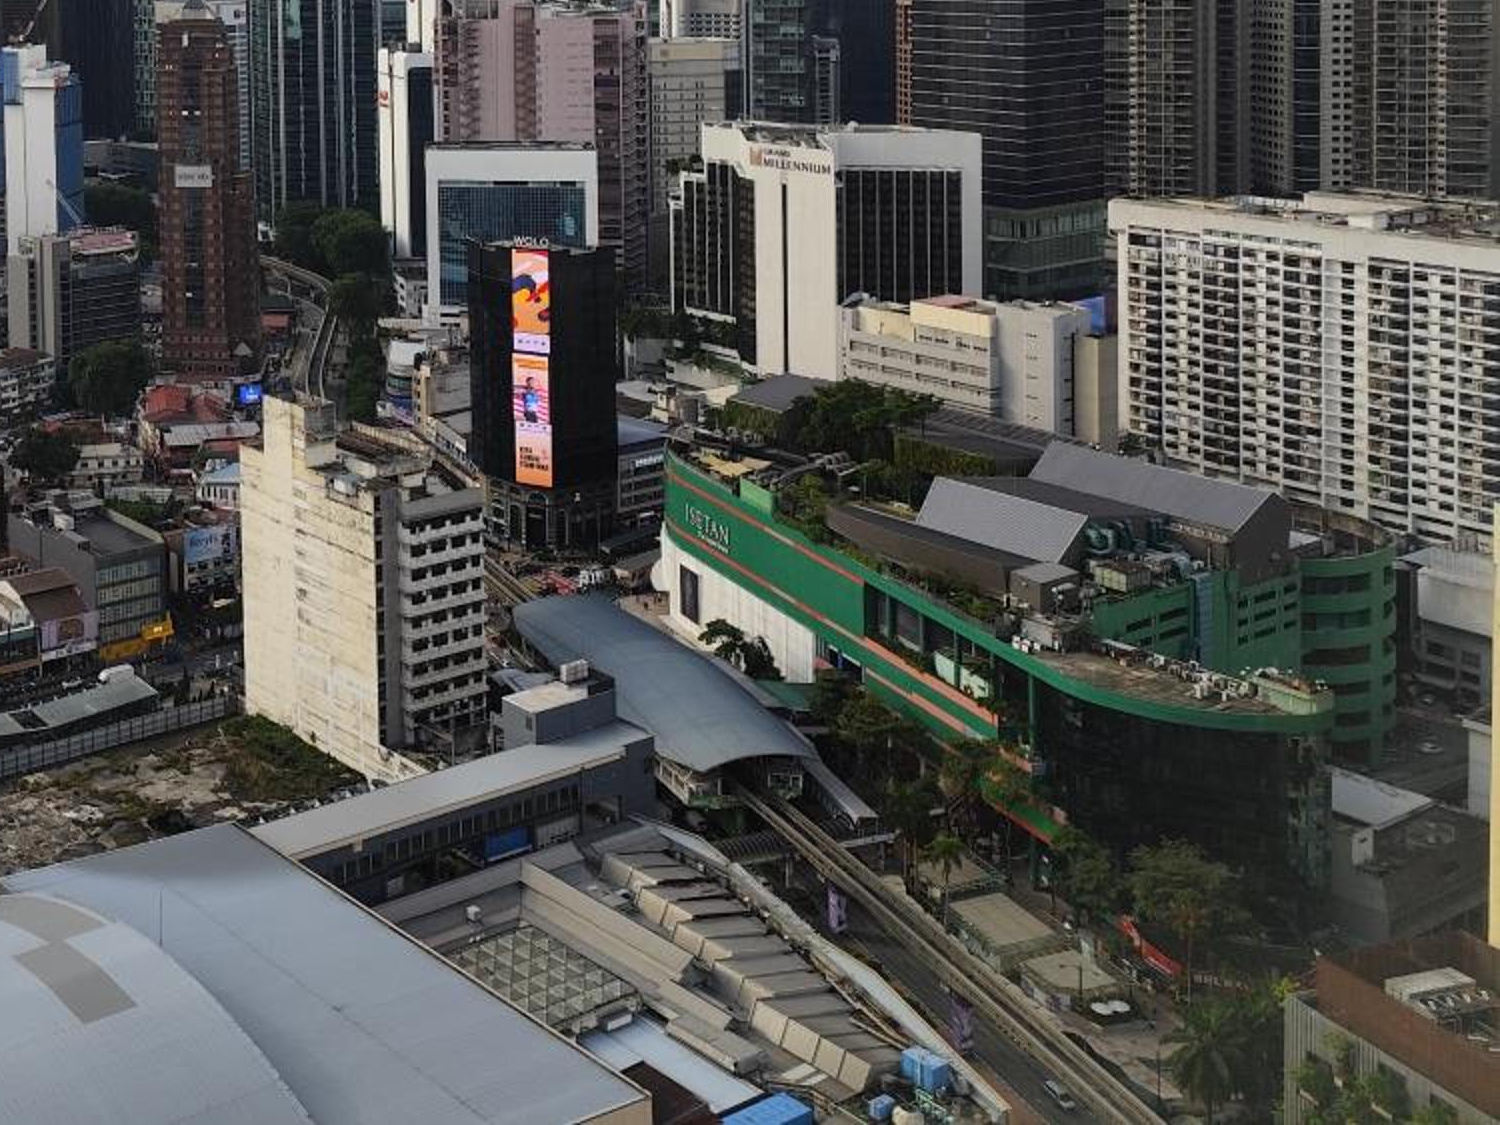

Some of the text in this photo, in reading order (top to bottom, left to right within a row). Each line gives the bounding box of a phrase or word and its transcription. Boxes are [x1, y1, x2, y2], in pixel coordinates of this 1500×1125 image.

[763, 157, 831, 174] MILLENNIUM
[513, 235, 549, 247] WOLO
[685, 503, 730, 545] ISETAN
